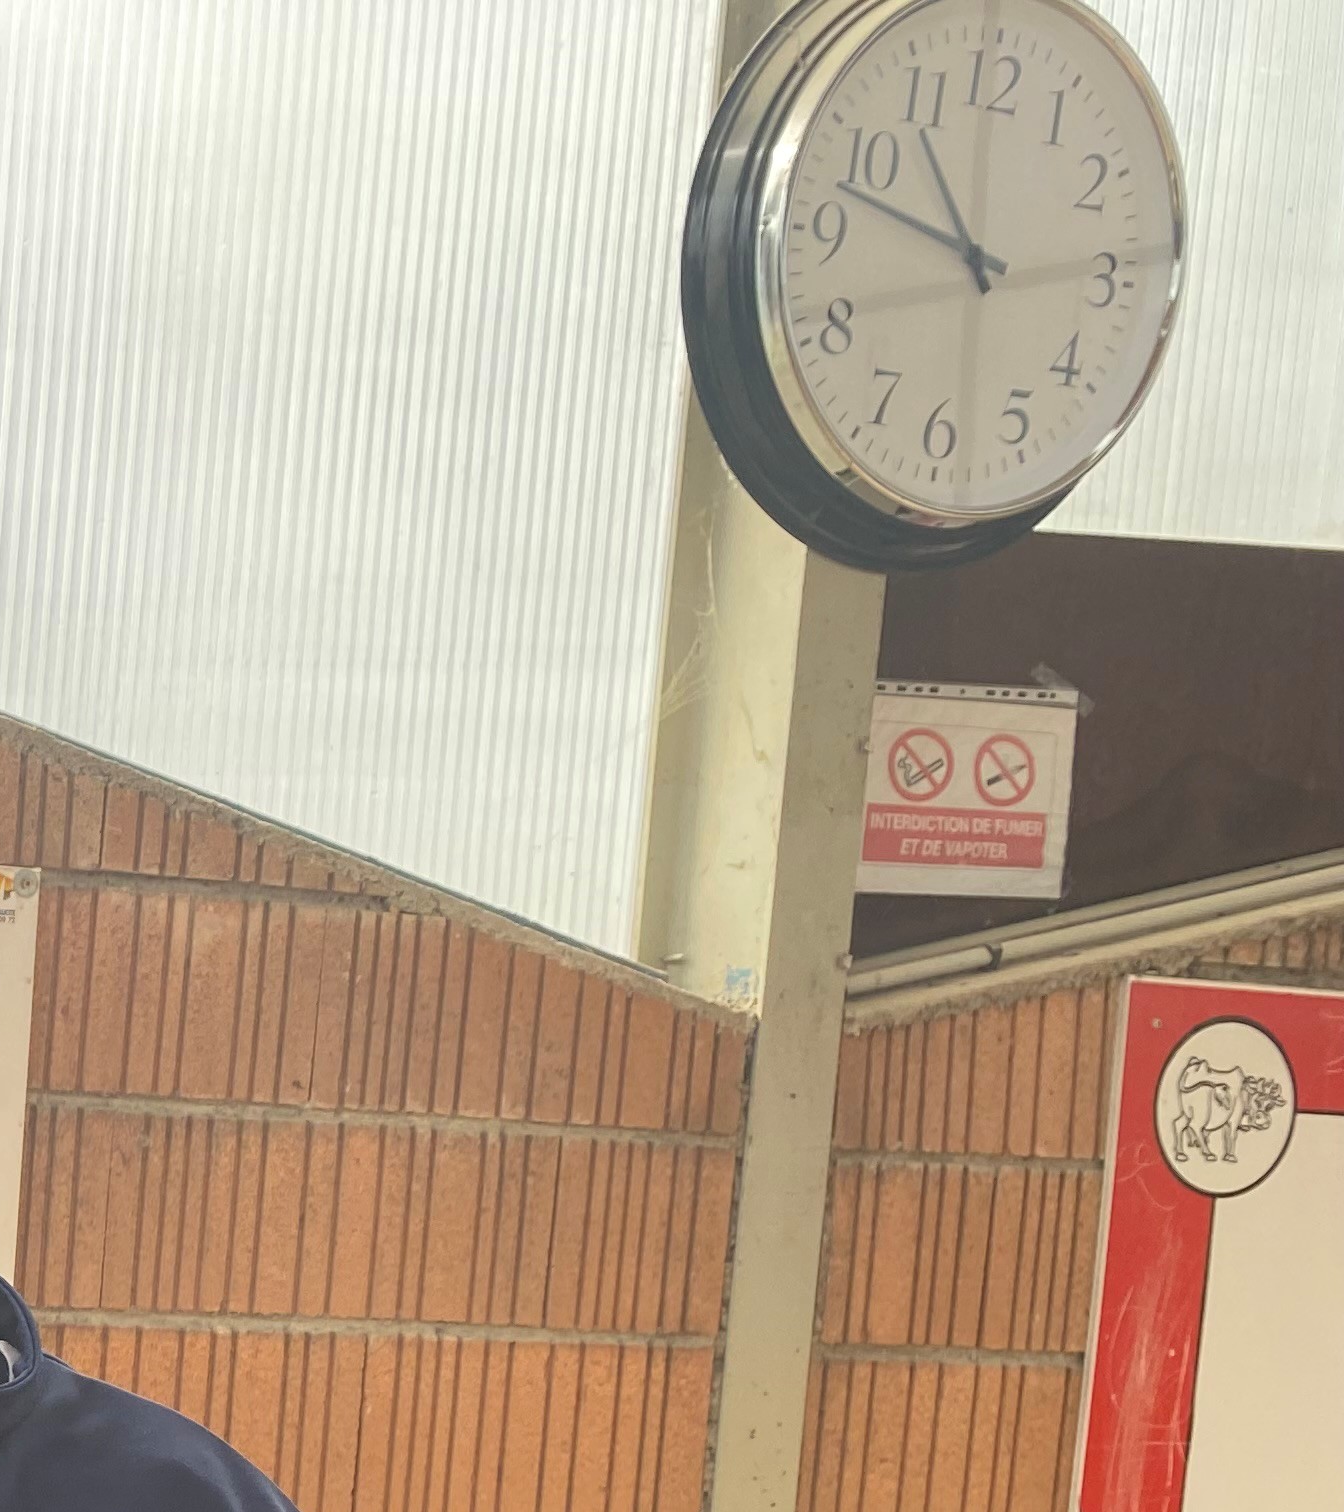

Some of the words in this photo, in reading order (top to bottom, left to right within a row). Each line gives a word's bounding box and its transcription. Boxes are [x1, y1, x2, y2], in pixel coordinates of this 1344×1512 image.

[900, 65, 947, 128] 11
[967, 48, 1023, 116] 12
[1040, 90, 1067, 147] 1
[845, 127, 901, 191] 10
[1073, 153, 1109, 214] 2
[811, 202, 849, 266] 9
[1092, 251, 1119, 308] 3
[819, 297, 856, 355] 8
[1048, 331, 1083, 388] 4
[867, 368, 904, 427] 7
[1000, 388, 1035, 447] 5
[923, 395, 959, 461] 6
[870, 812, 969, 833] INTERDICTION
[971, 817, 992, 834] DE
[994, 818, 1044, 837] FUMER
[899, 837, 921, 856] ET
[922, 838, 943, 857] DE
[943, 840, 1009, 861] VAPOTER
